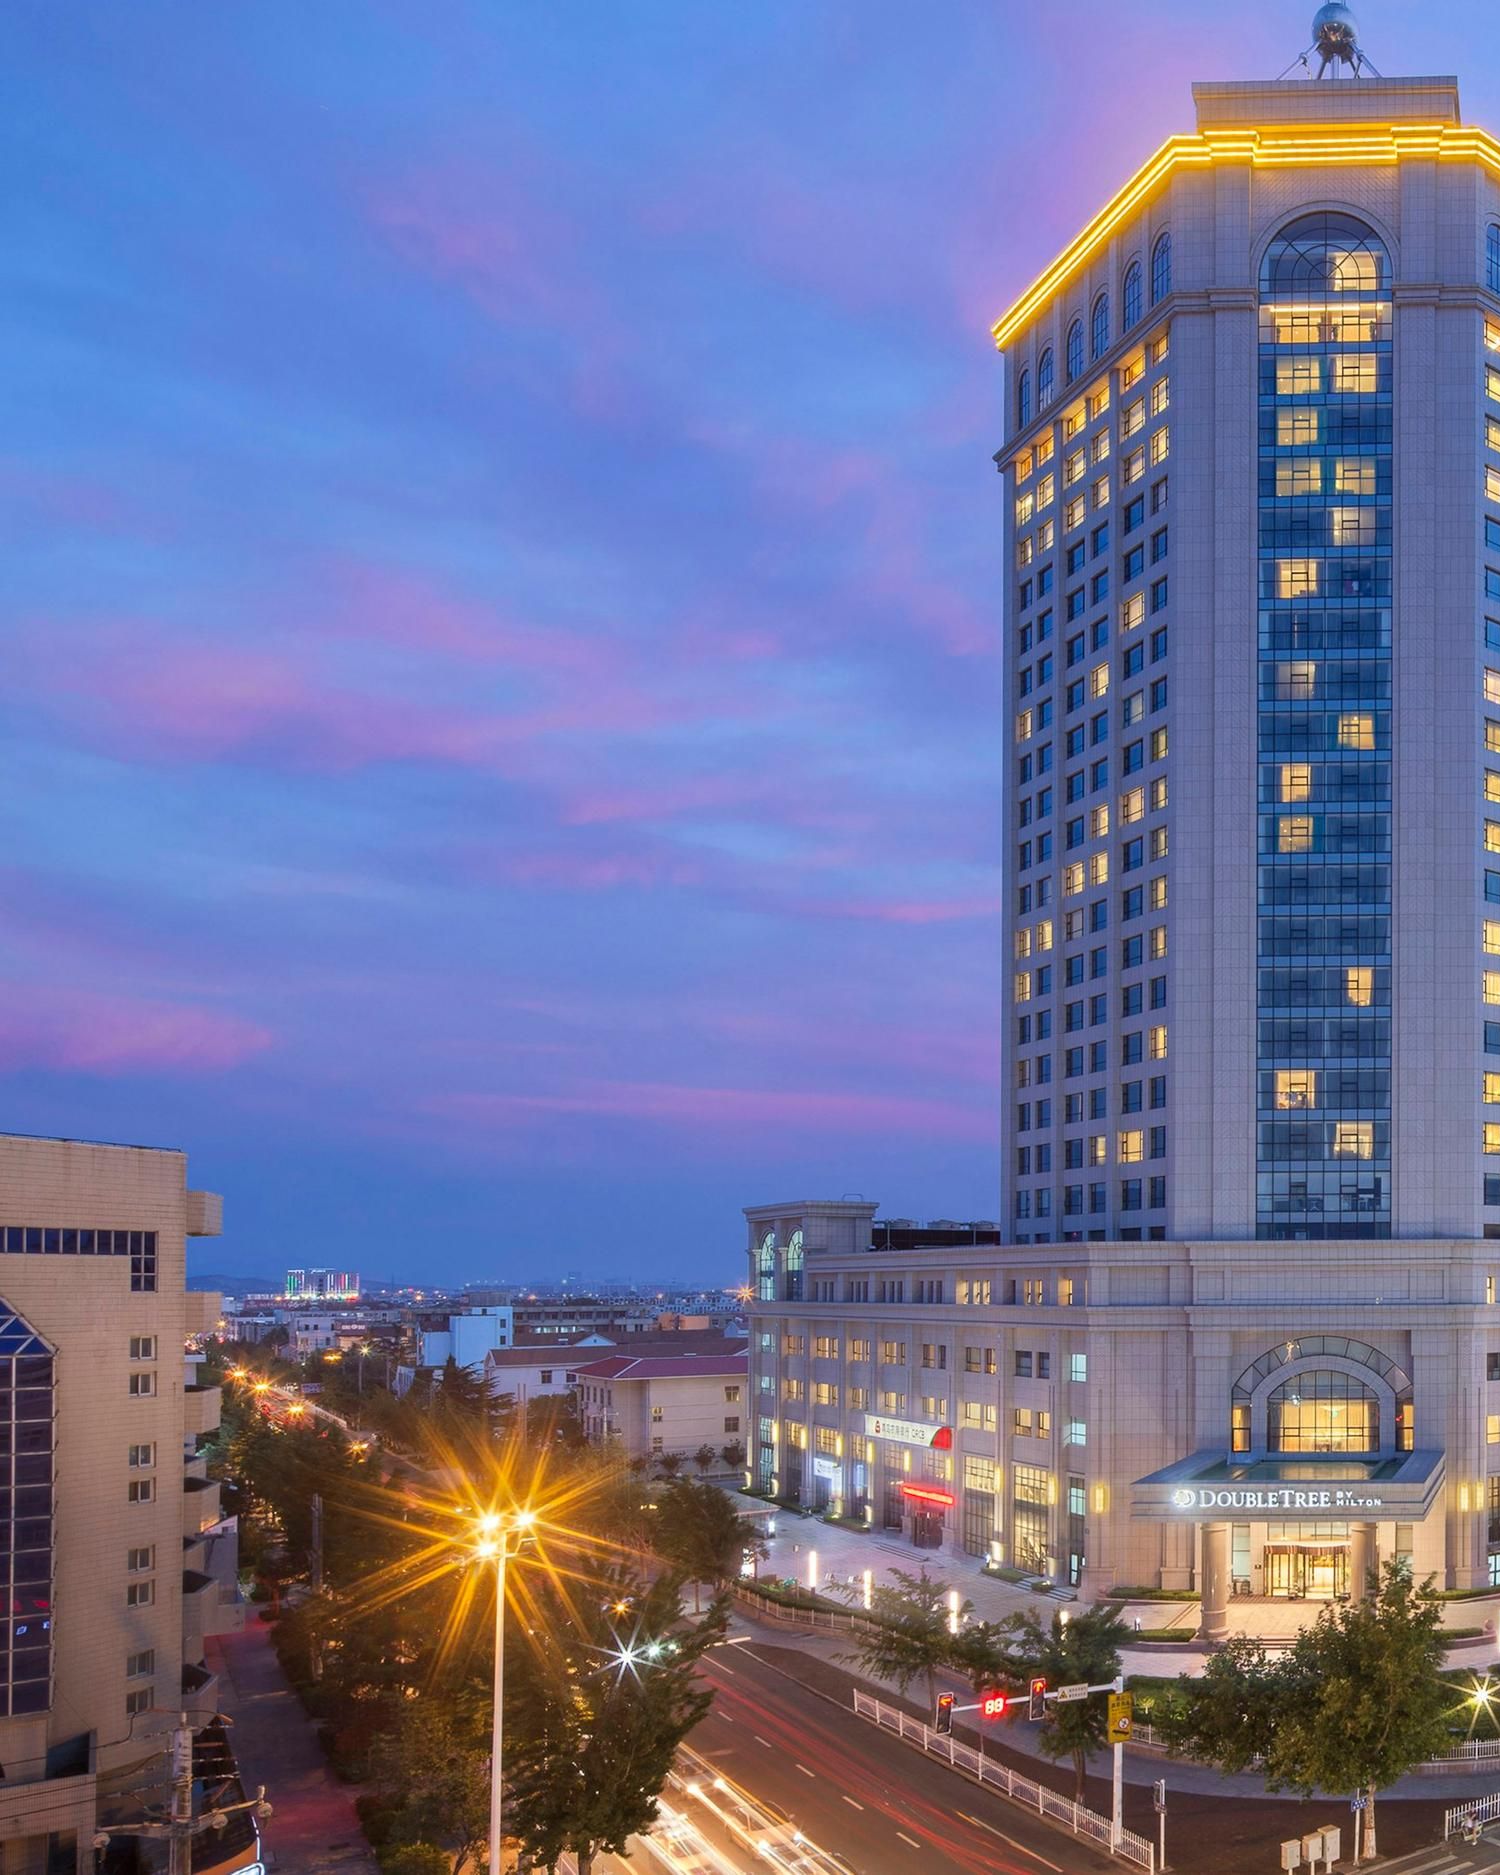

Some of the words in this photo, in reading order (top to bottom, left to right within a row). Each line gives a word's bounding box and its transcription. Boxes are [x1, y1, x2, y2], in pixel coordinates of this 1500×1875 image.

[1199, 1489, 1331, 1508] DOUBLETREE
[1336, 1490, 1353, 1499] BY
[1336, 1498, 1382, 1507] HILTON
